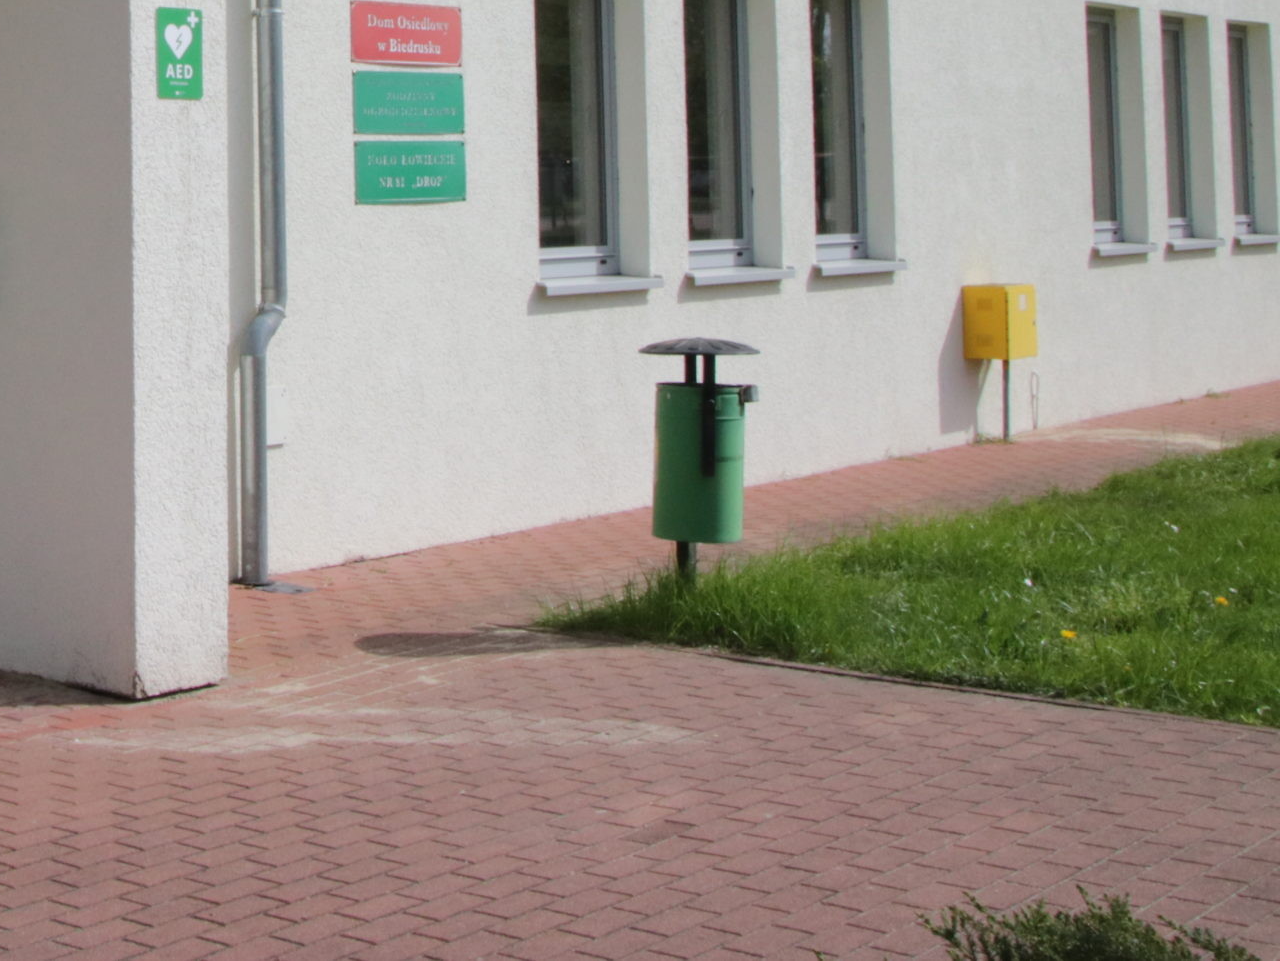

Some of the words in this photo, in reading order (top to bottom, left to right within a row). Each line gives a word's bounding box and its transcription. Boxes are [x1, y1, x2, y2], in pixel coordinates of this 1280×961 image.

[367, 14, 395, 29] Dom
[397, 15, 450, 36] Osiedlowy
[377, 42, 387, 52] w
[389, 38, 442, 55] Biedrusku
[165, 63, 194, 80] AED
